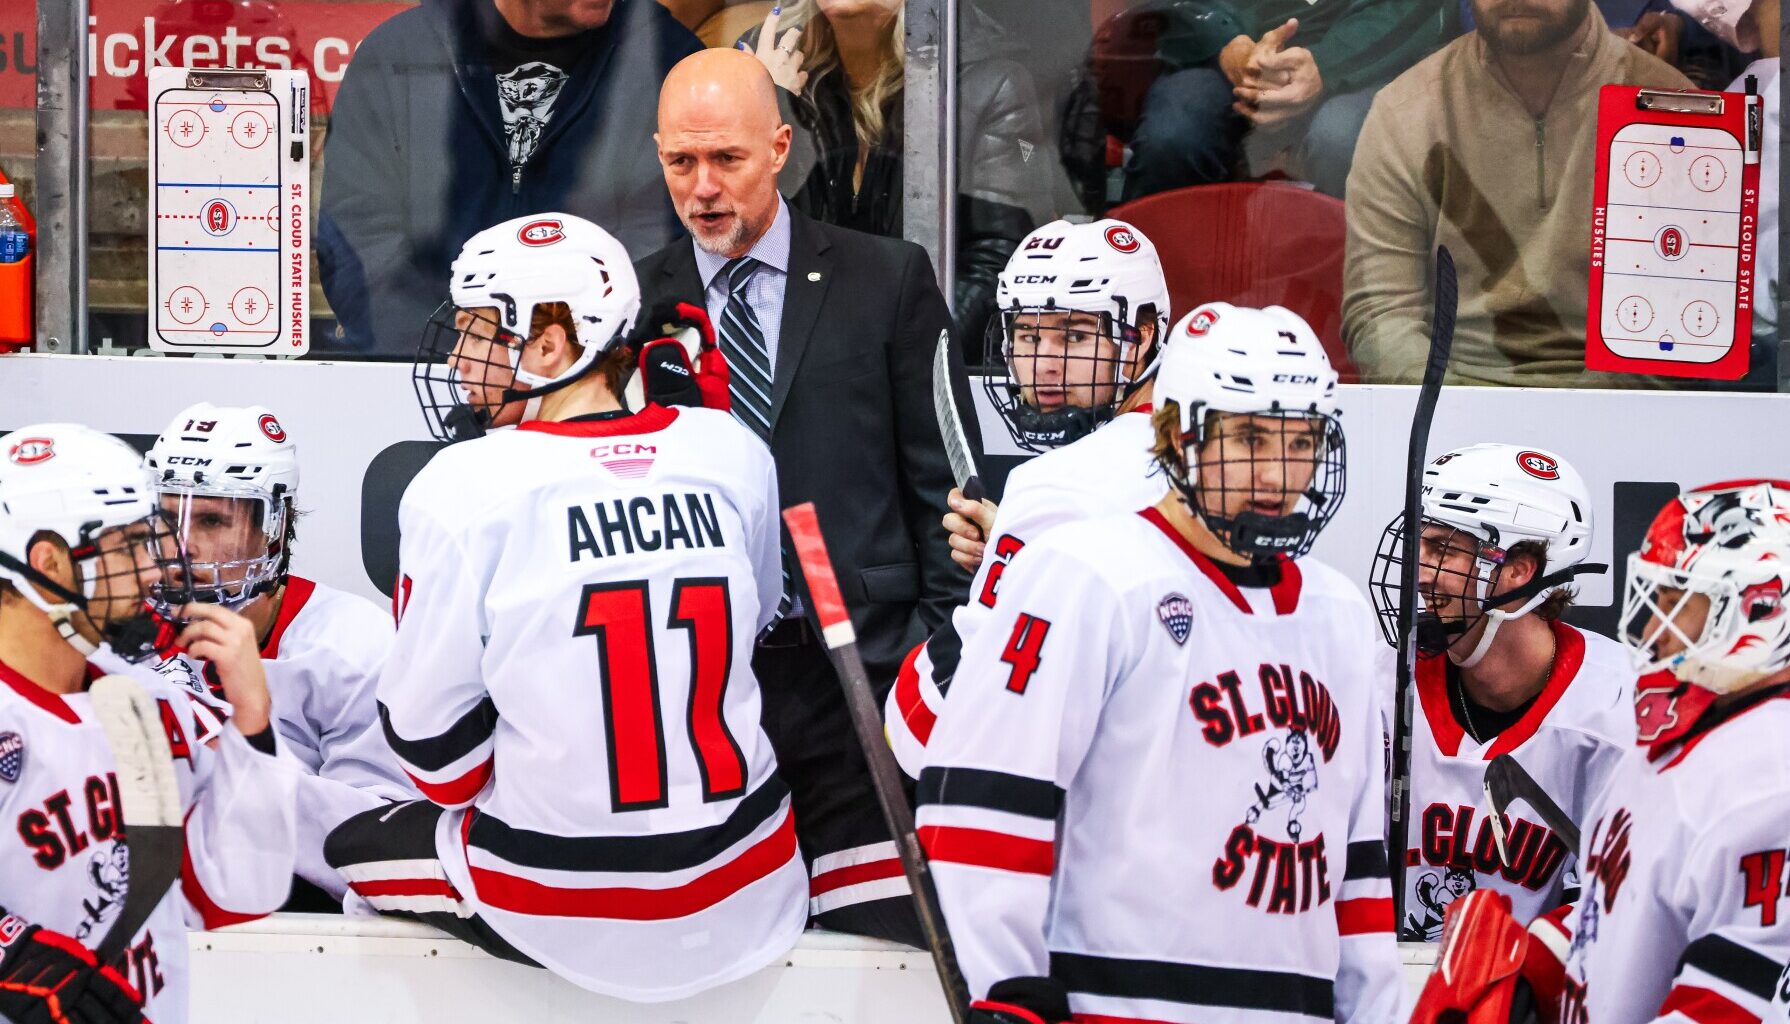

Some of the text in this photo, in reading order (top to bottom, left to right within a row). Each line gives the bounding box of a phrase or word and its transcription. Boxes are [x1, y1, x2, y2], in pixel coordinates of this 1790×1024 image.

[1592, 207, 1605, 267] HUSKIES
[1741, 215, 1753, 262] CLOUD
[291, 183, 302, 347] ST. CLOUD STATE HUSKIES
[1014, 275, 1058, 284] CCM
[1738, 269, 1750, 309] STATE
[660, 361, 689, 376] CCM
[1272, 374, 1318, 384] CCM
[590, 444, 657, 458] CCM
[1024, 430, 1066, 440] CCM
[167, 456, 213, 467] CCM
[567, 492, 726, 563] AHCAN
[1255, 535, 1300, 547] CCM
[1000, 612, 1052, 697] 4
[572, 576, 748, 813] 11
[1212, 823, 1331, 915] STATE
